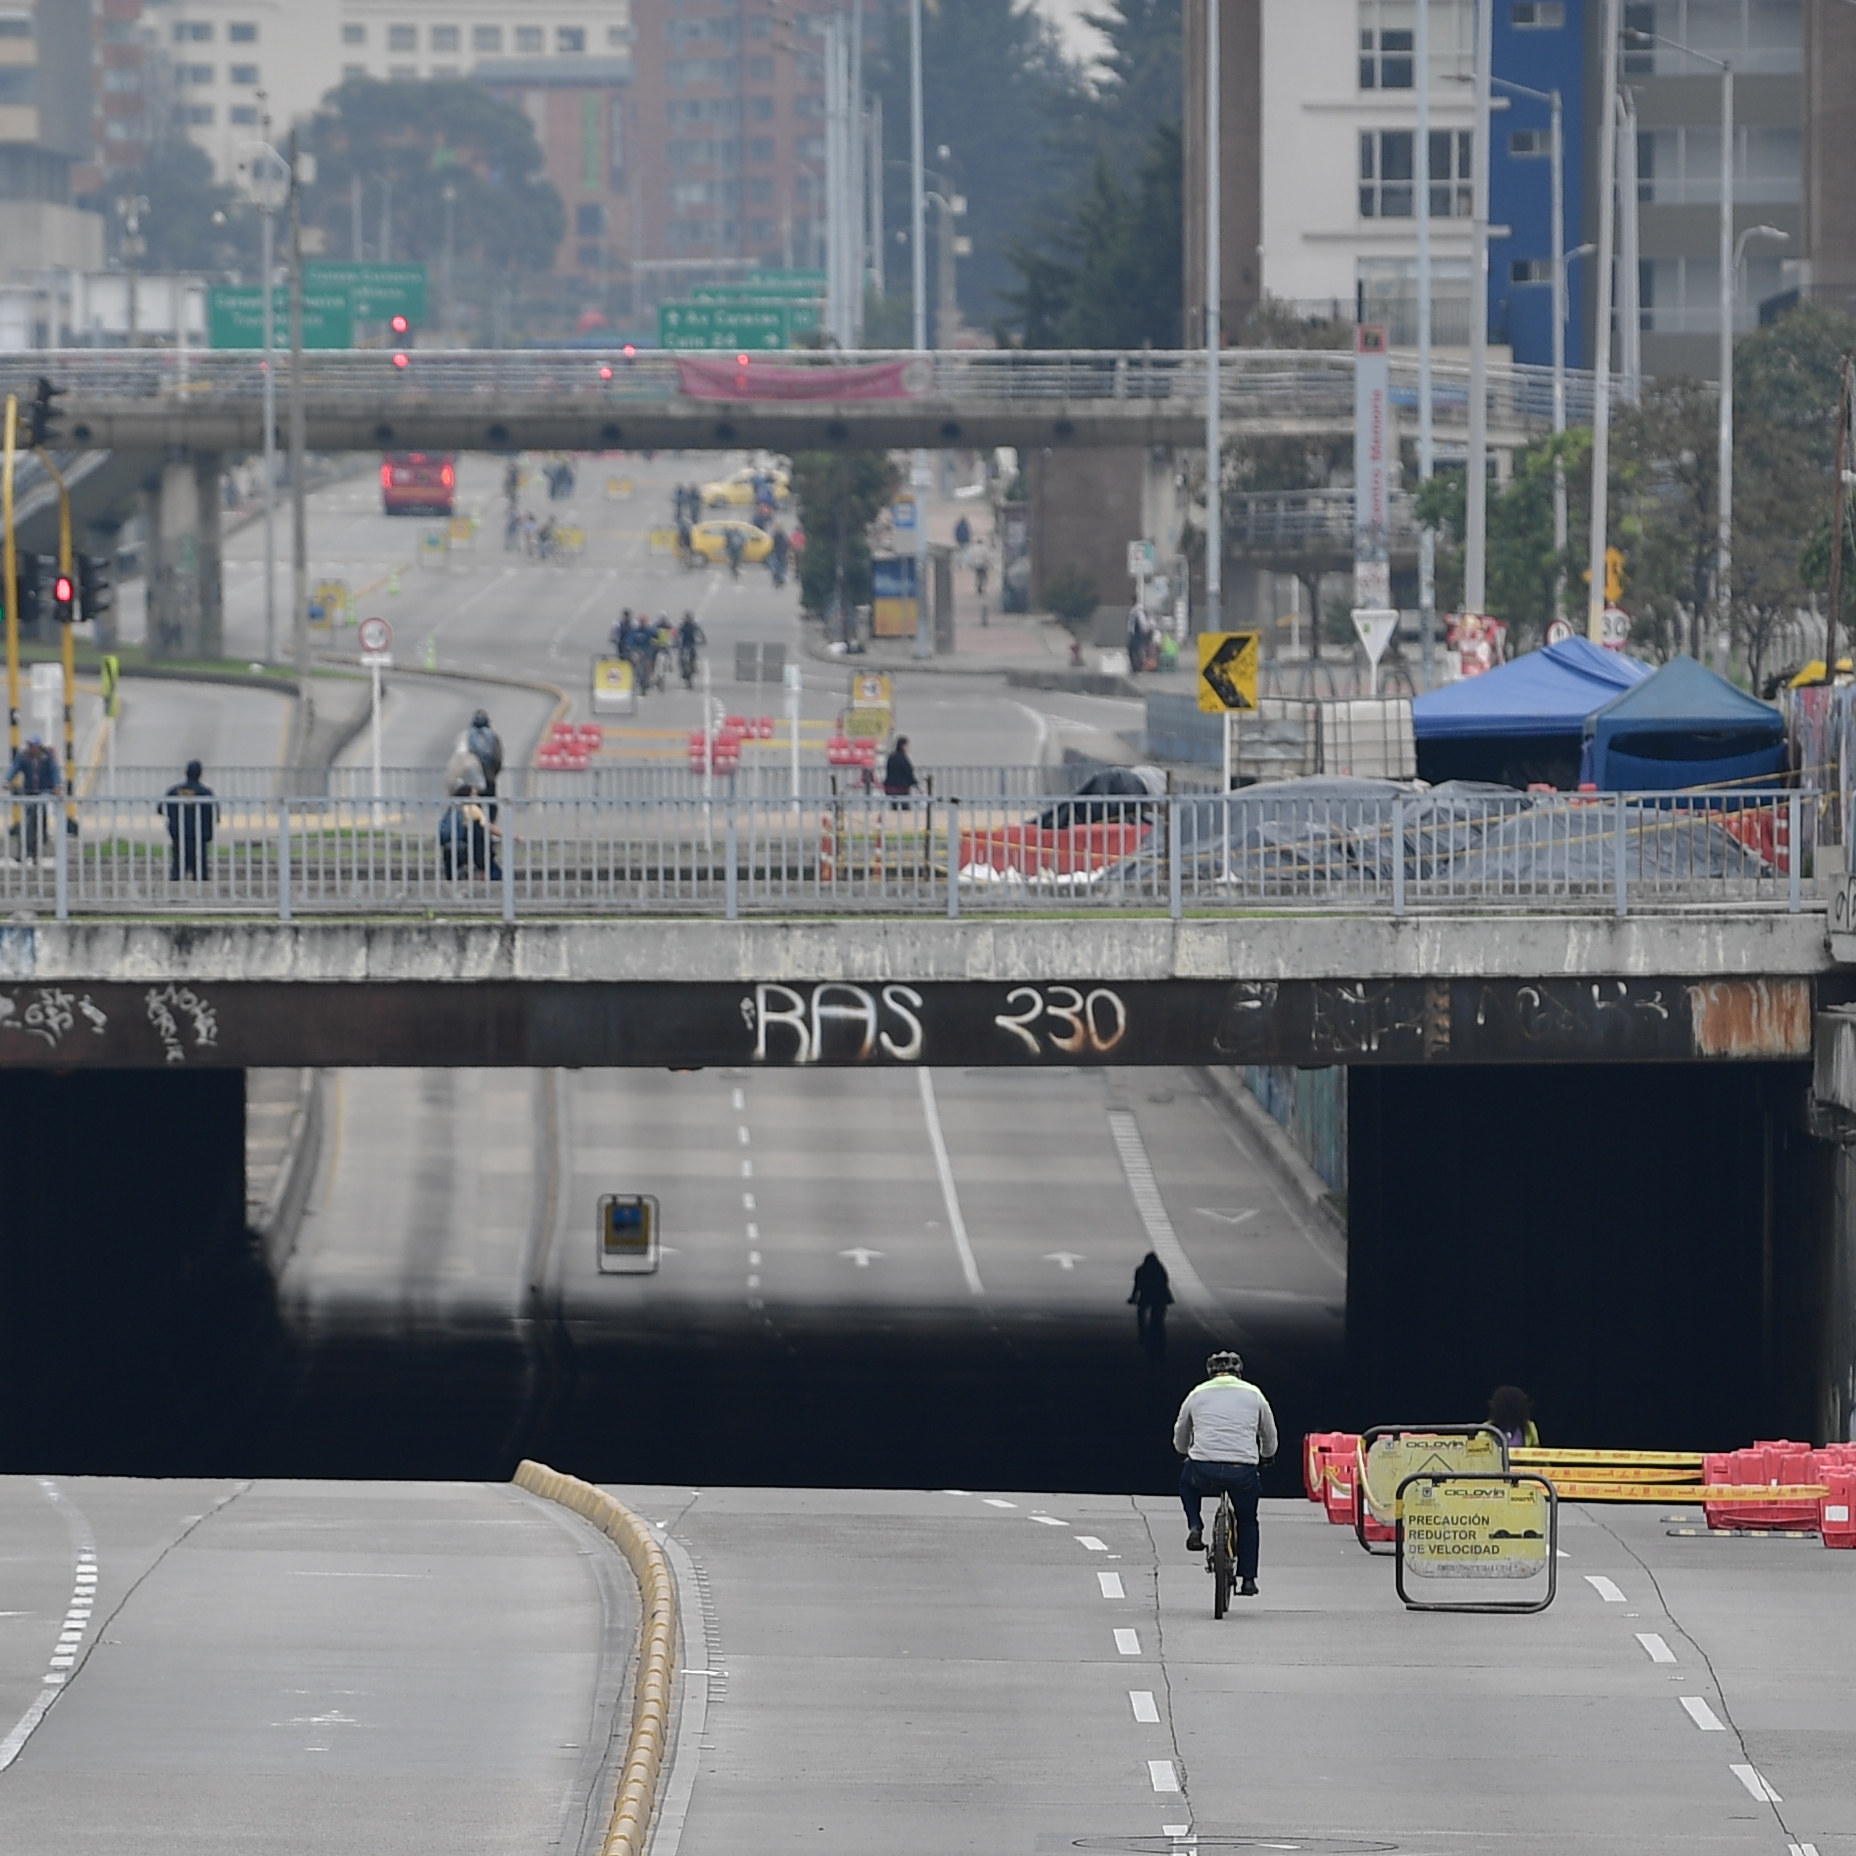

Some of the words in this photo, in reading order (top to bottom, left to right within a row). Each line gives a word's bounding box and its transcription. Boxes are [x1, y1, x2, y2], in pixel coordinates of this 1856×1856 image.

[754, 983, 923, 1063] RAS
[995, 986, 1127, 1054] 230
[1408, 1513, 1490, 1526] PRECAUCIÓN
[1408, 1530, 1477, 1541] REDUCTOR
[1409, 1545, 1425, 1555] DE
[1428, 1545, 1500, 1555] VELOCIDAD
